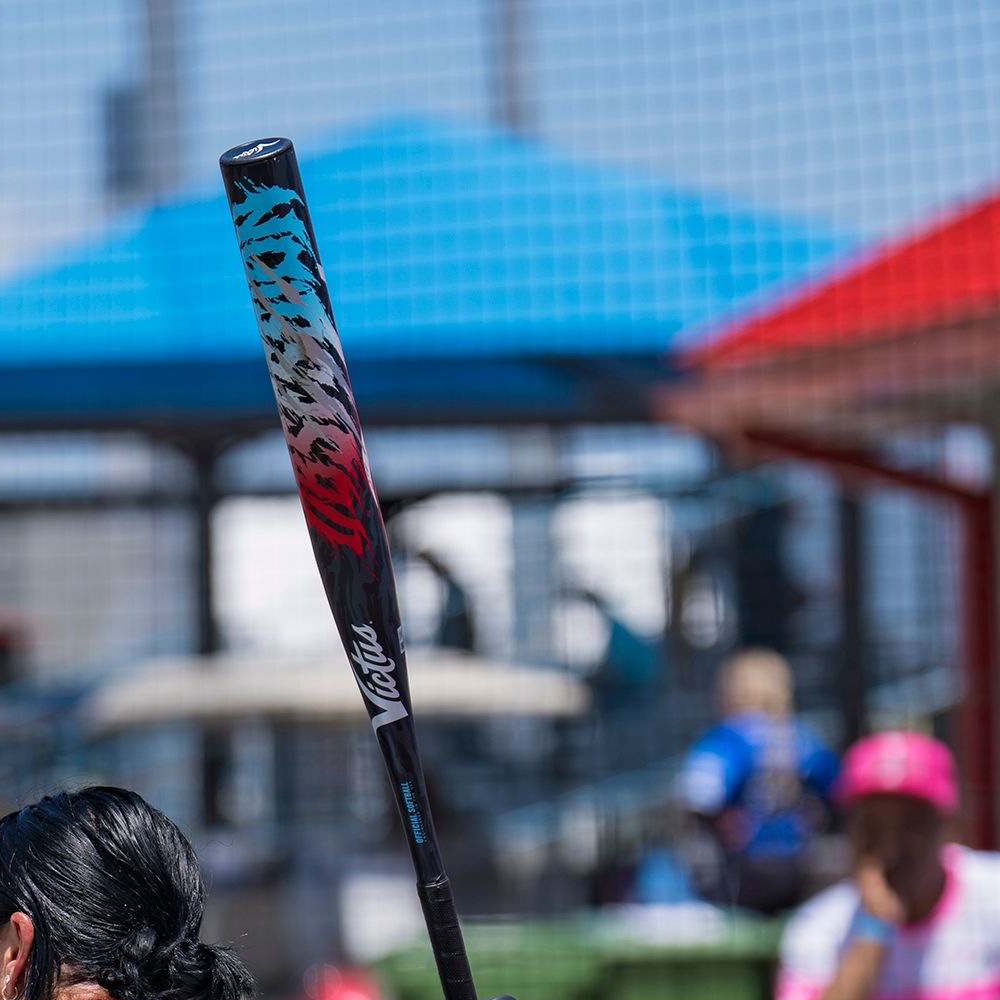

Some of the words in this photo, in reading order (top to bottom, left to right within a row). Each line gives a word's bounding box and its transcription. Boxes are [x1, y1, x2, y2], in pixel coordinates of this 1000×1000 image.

[350, 622, 409, 738] Victus
[401, 781, 416, 812] SOFTBALL
[409, 814, 424, 844] OFFICIAL
